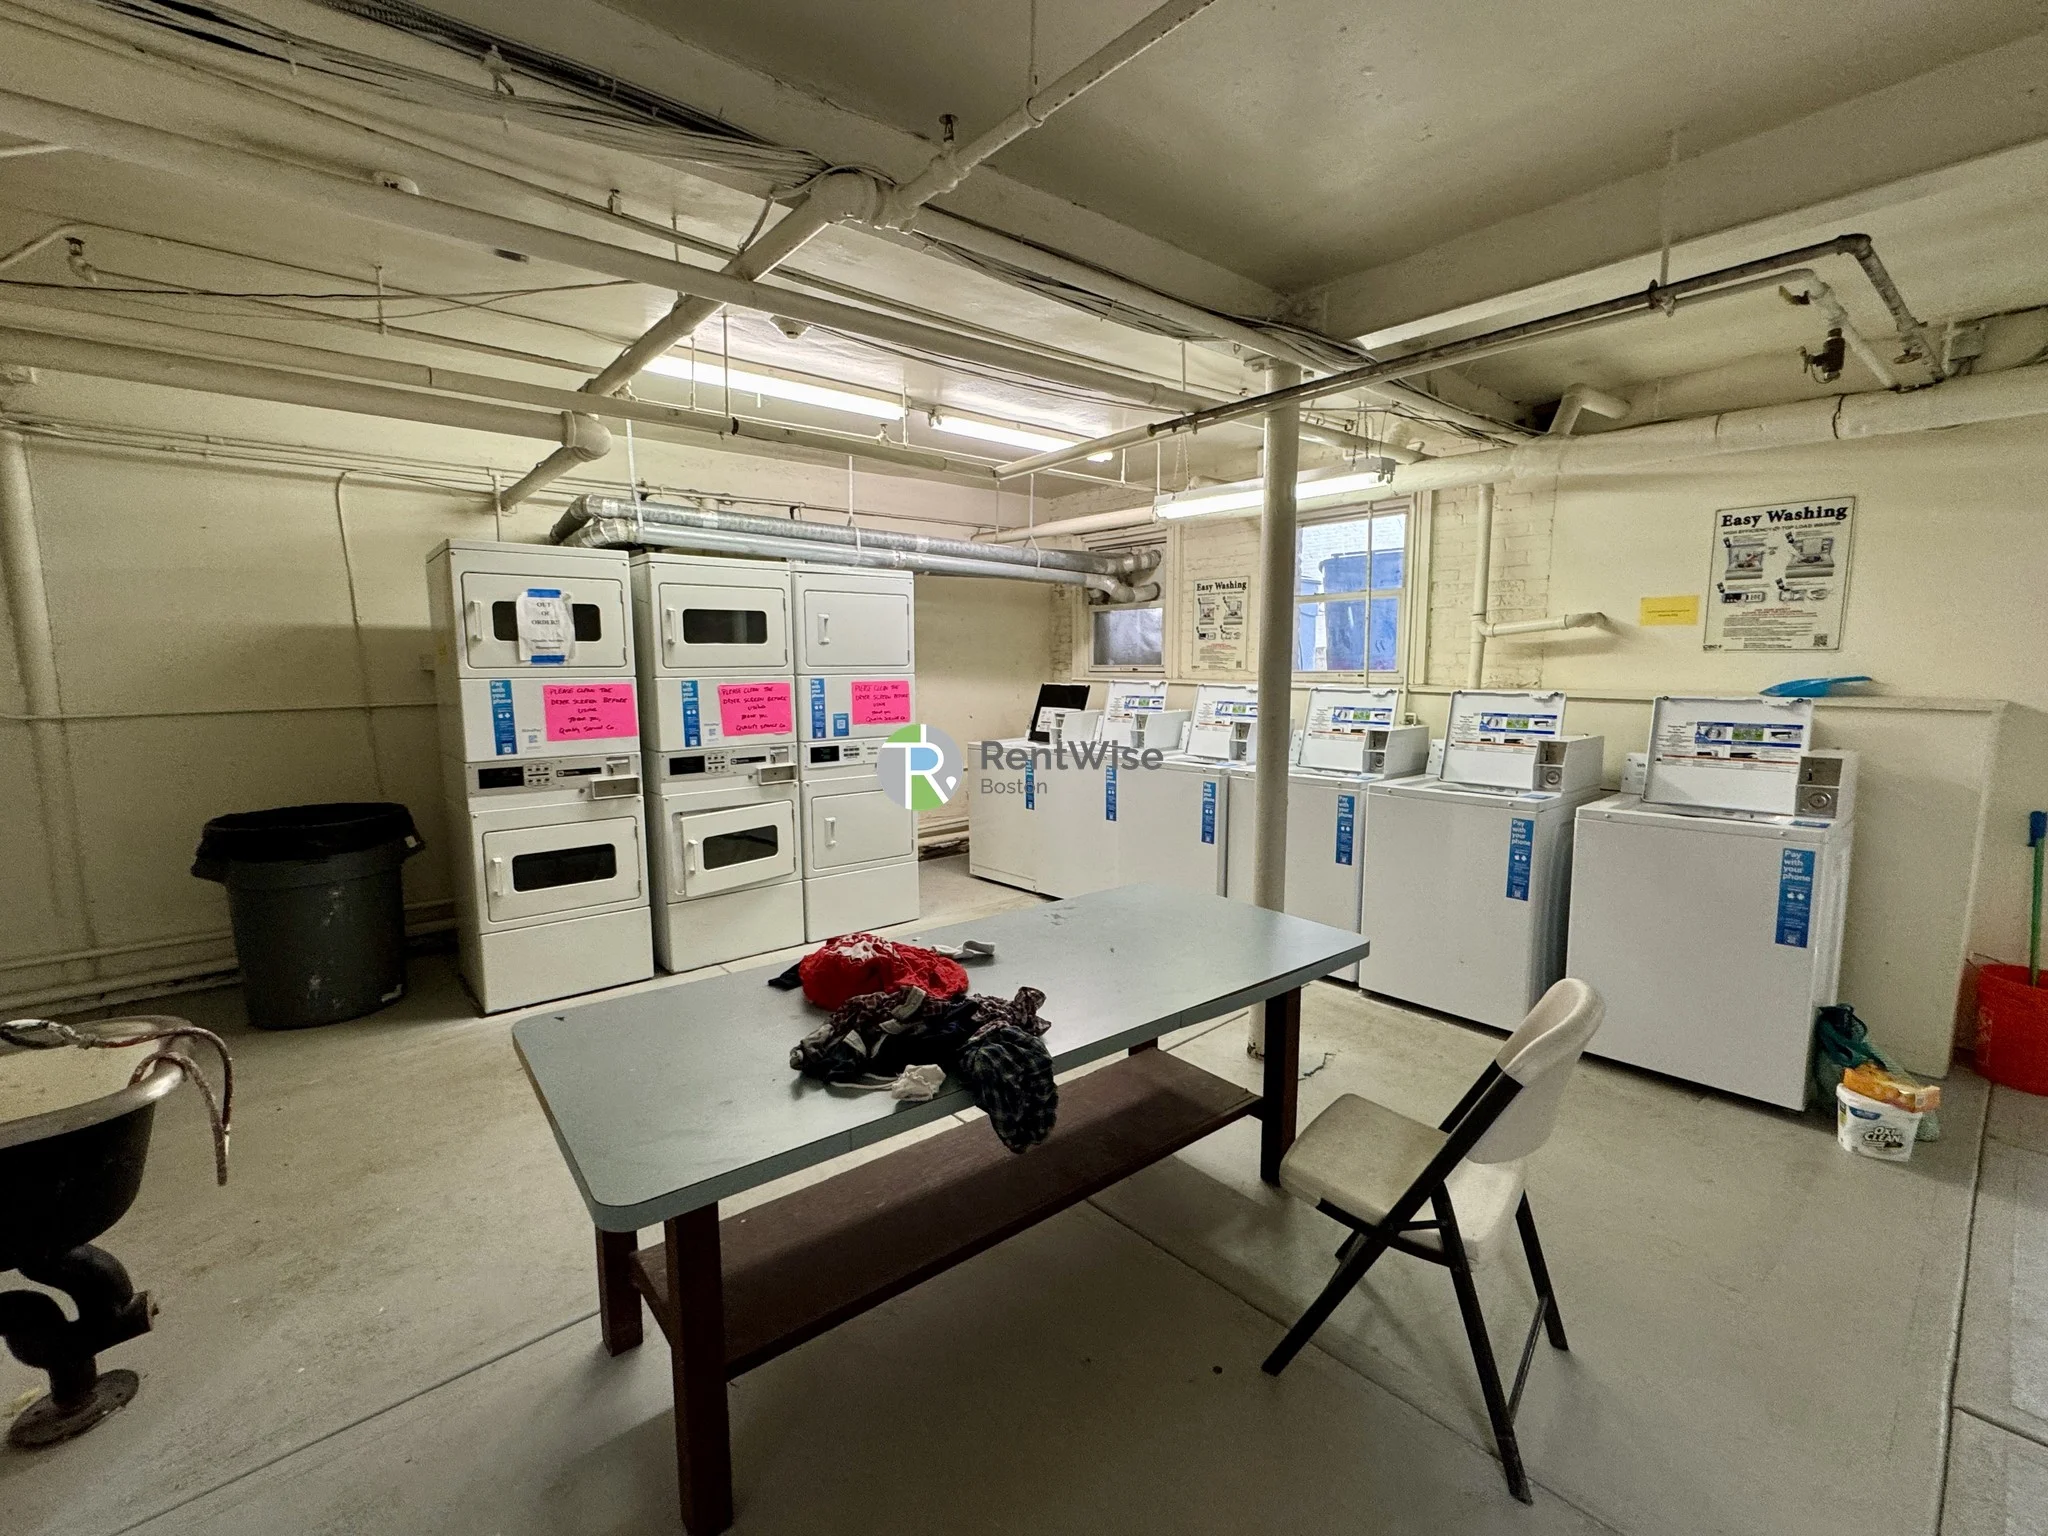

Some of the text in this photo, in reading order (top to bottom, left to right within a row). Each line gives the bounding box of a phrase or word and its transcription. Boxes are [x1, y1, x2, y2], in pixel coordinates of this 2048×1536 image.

[1721, 506, 1848, 528] Easy Washing
[1197, 581, 1247, 592] Easy Washing
[1513, 820, 1525, 828] Pay
[1512, 832, 1526, 840] your
[1784, 850, 1802, 860] Pay
[1784, 859, 1804, 867] with
[1783, 866, 1803, 874] your
[1782, 873, 1811, 882] phone
[1863, 1131, 1902, 1142] CLEAN
